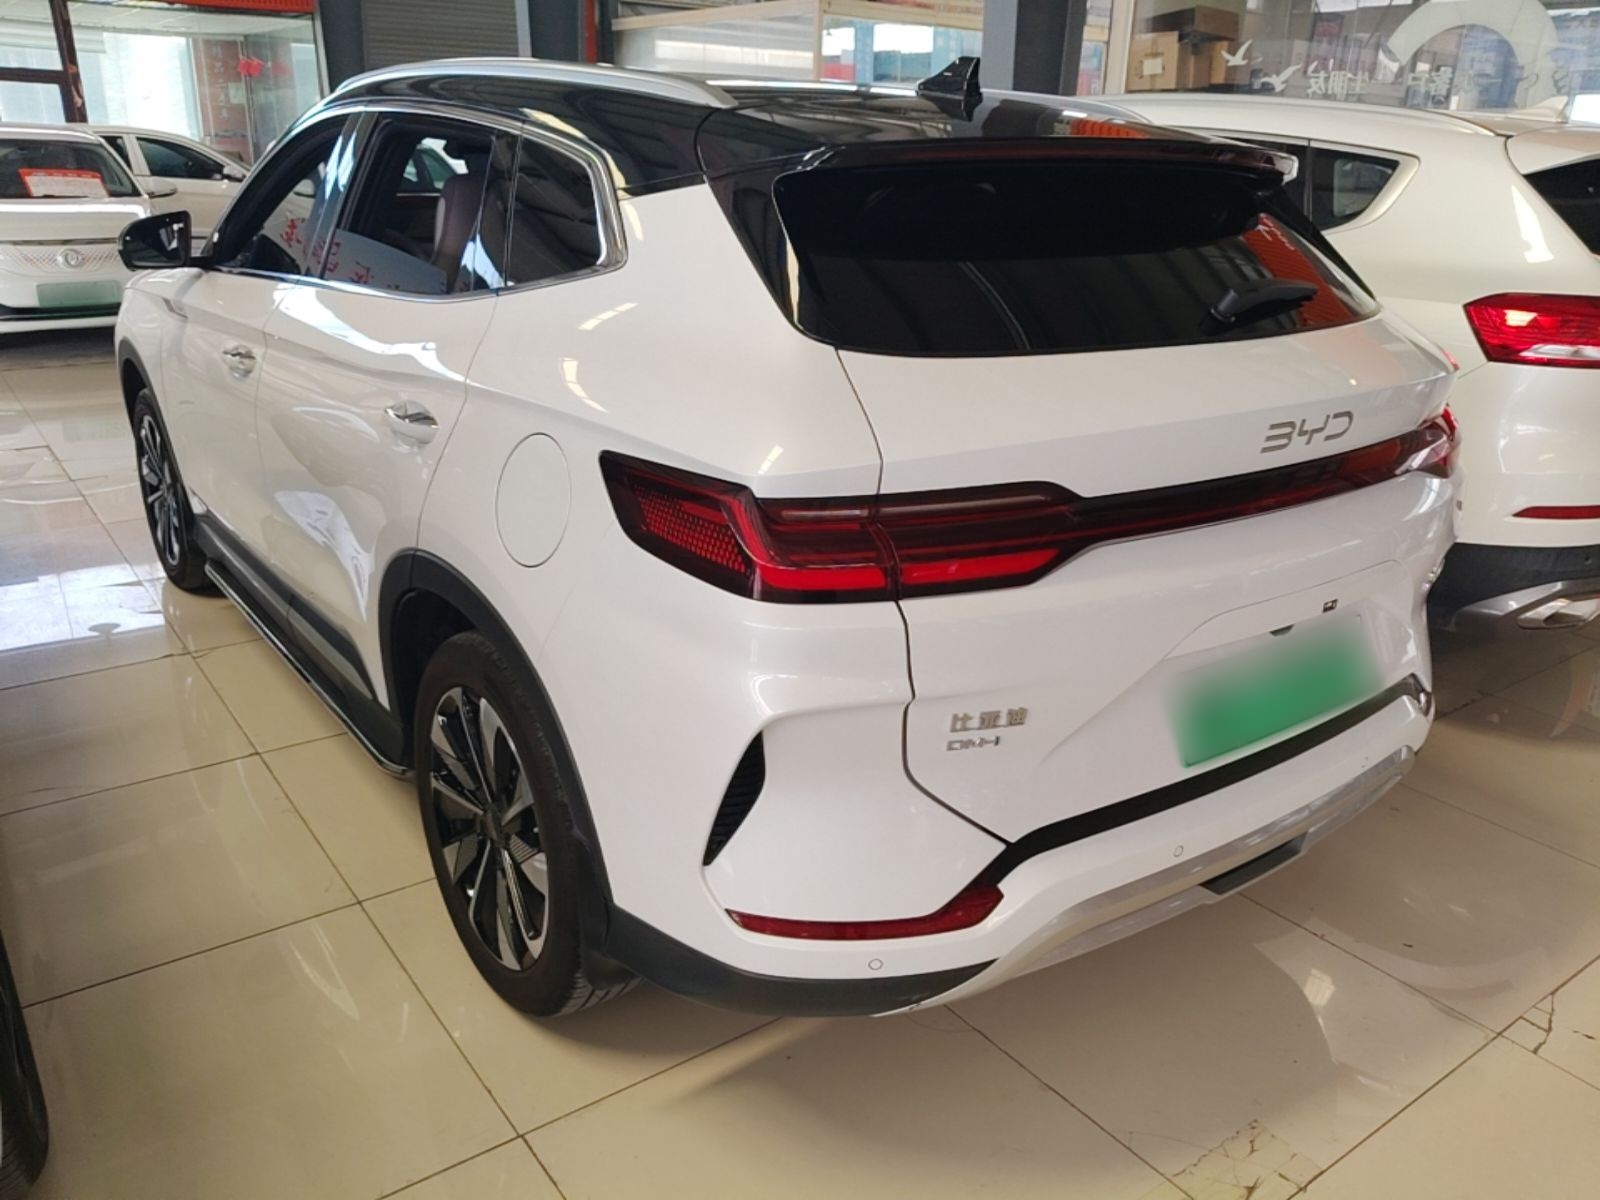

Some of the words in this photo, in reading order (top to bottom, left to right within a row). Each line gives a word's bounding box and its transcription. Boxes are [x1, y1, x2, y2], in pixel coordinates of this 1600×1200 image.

[1260, 410, 1354, 454] BYD
[950, 707, 1029, 733] 比亚迪
